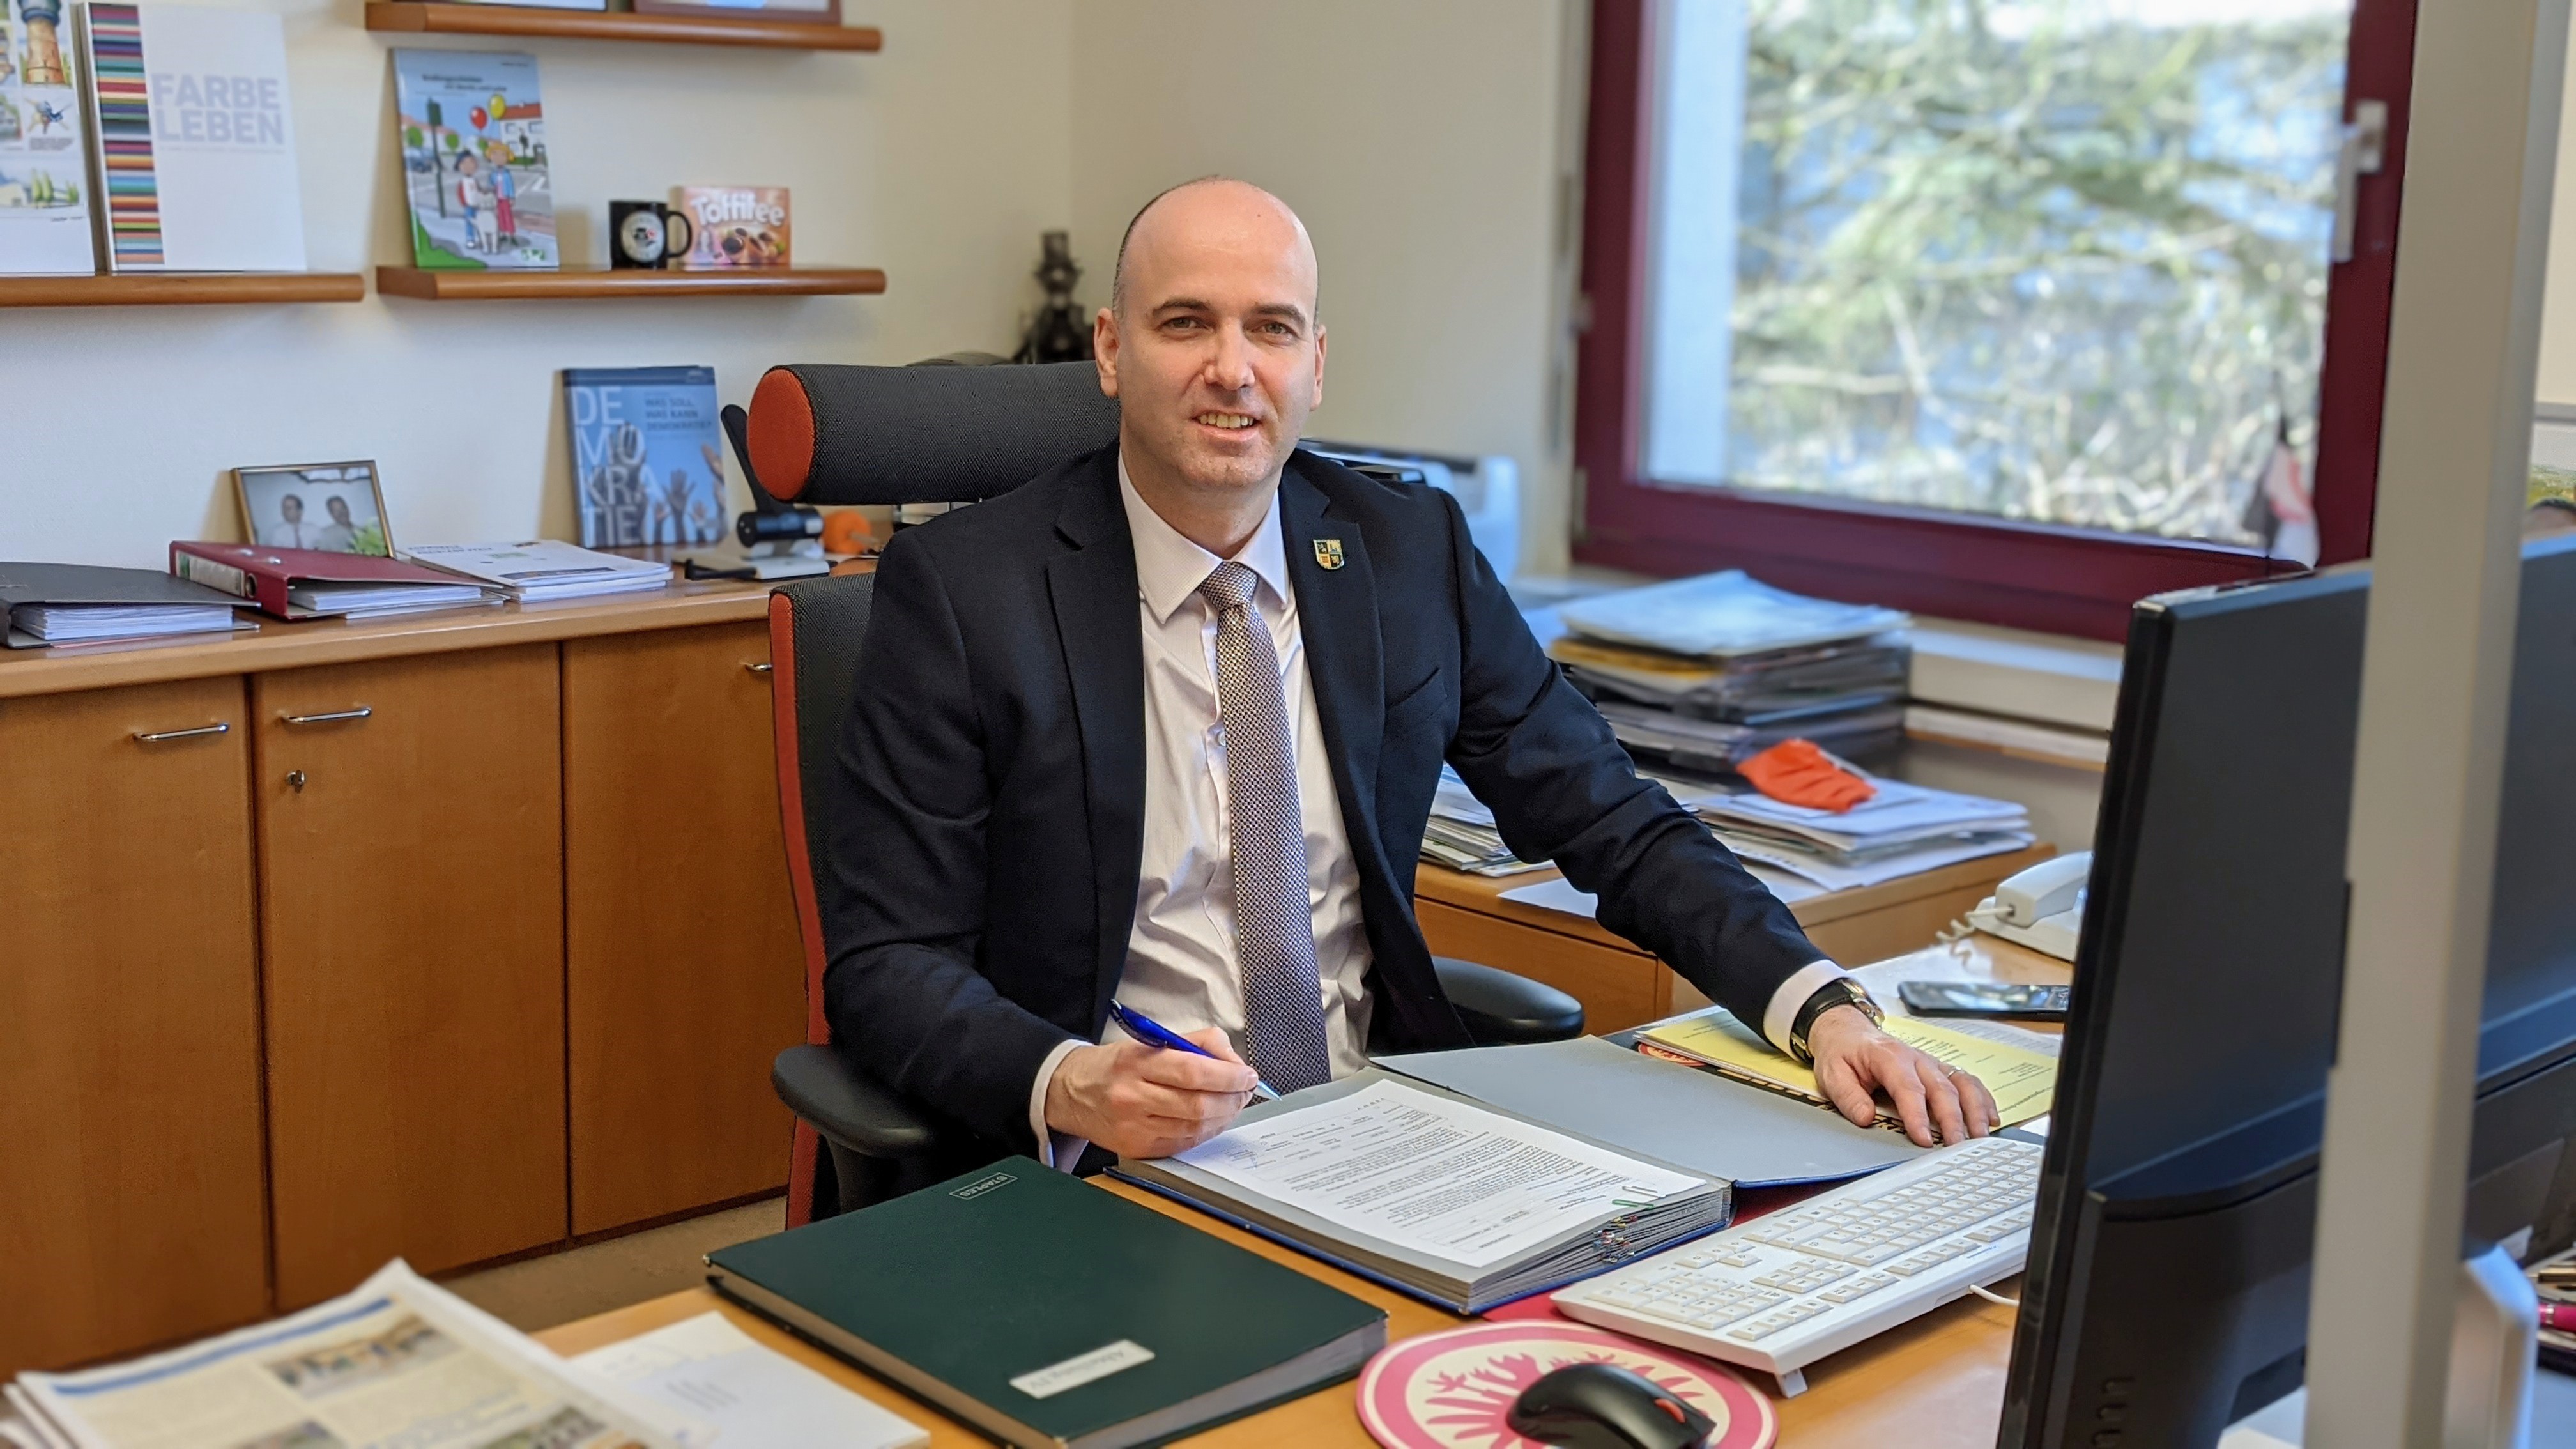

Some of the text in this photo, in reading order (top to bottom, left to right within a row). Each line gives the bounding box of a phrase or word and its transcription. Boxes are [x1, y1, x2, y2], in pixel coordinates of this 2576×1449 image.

[151, 73, 281, 110] FARBE
[157, 109, 285, 145] LEBEN
[690, 190, 785, 227] Toffifee
[572, 386, 625, 427] DE
[576, 423, 647, 467] MO
[579, 464, 664, 508] KRA
[582, 505, 640, 549] TIE
[960, 1176, 1008, 1197] STAPLES
